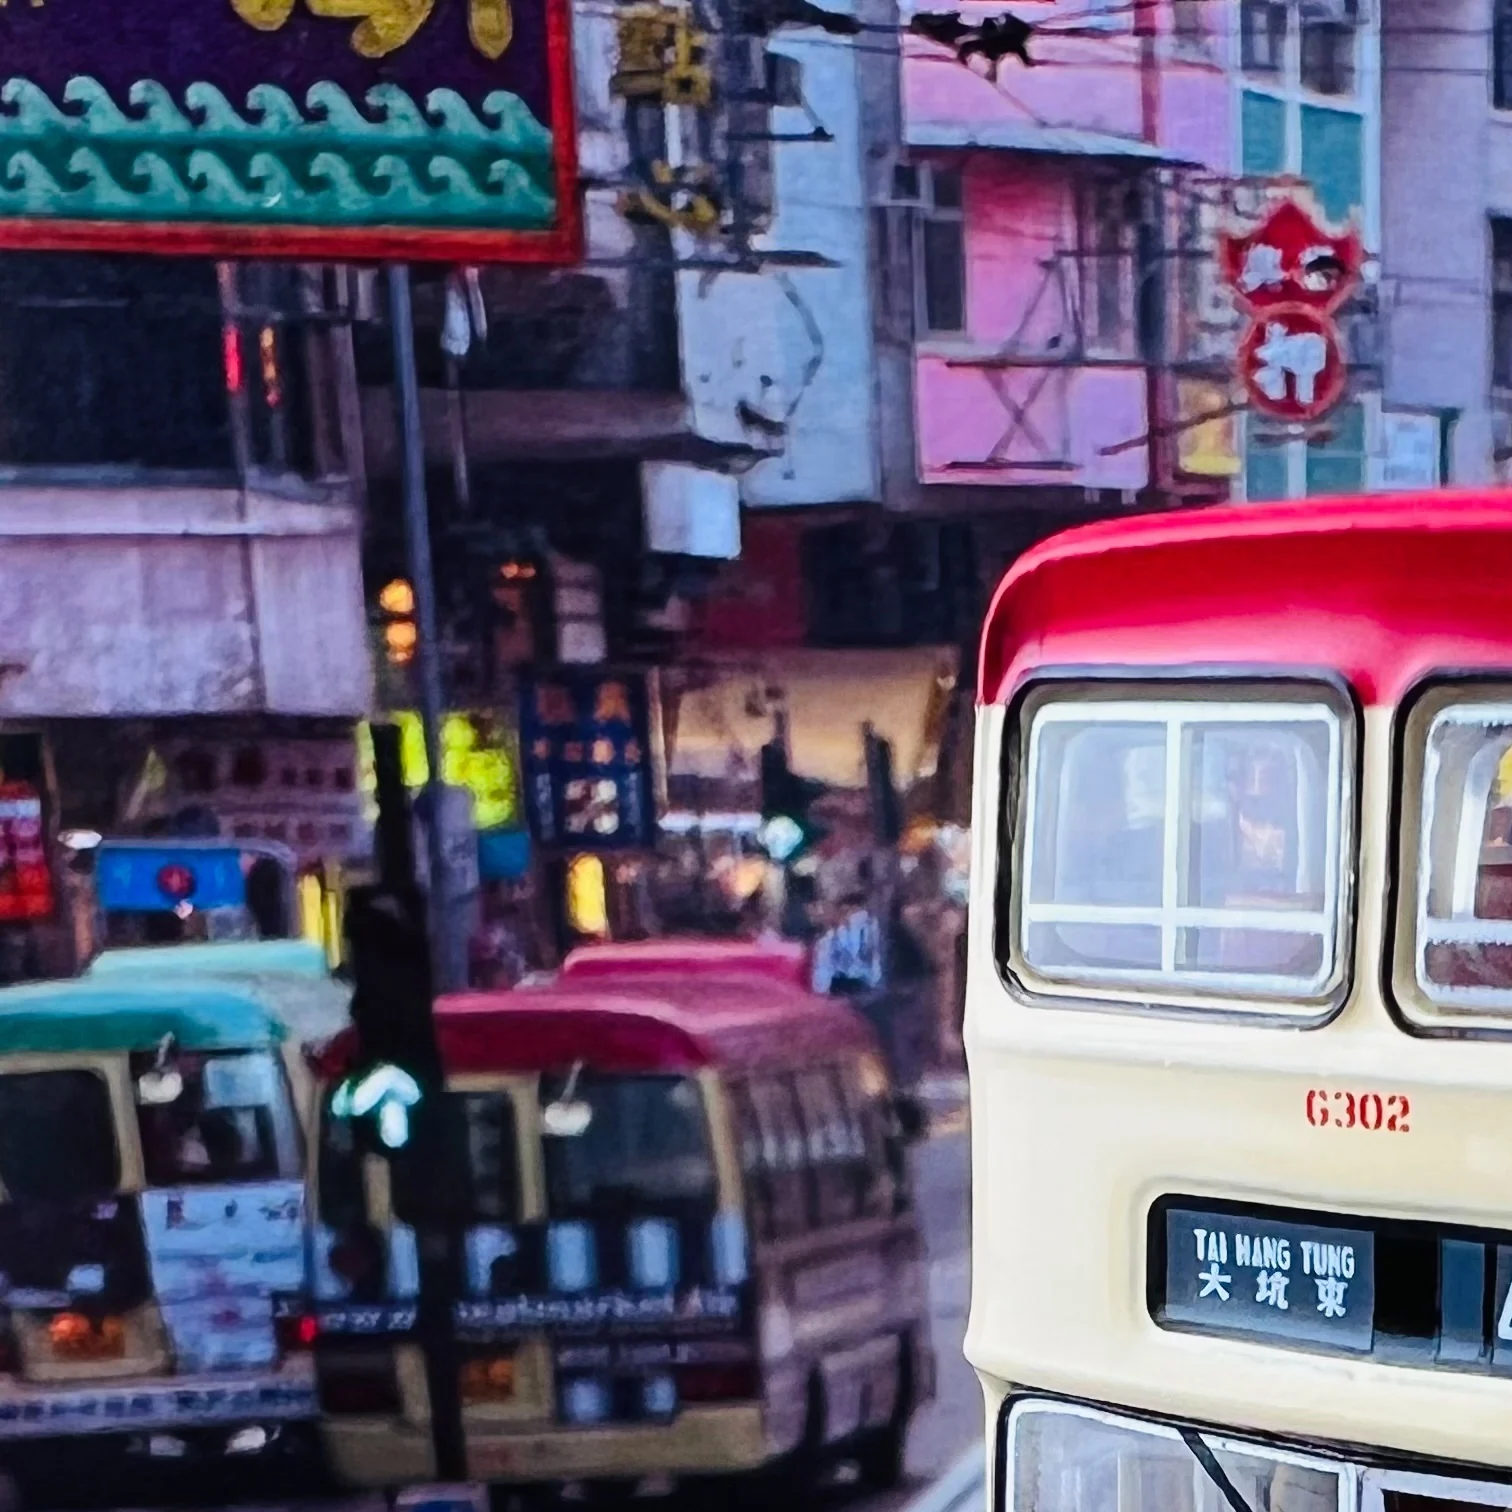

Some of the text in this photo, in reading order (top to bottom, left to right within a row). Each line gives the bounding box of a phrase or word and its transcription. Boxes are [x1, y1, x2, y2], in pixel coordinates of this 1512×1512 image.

[1193, 1228, 1356, 1279] TAI HANG TUNG
[1198, 1262, 1348, 1318] 大坑東
